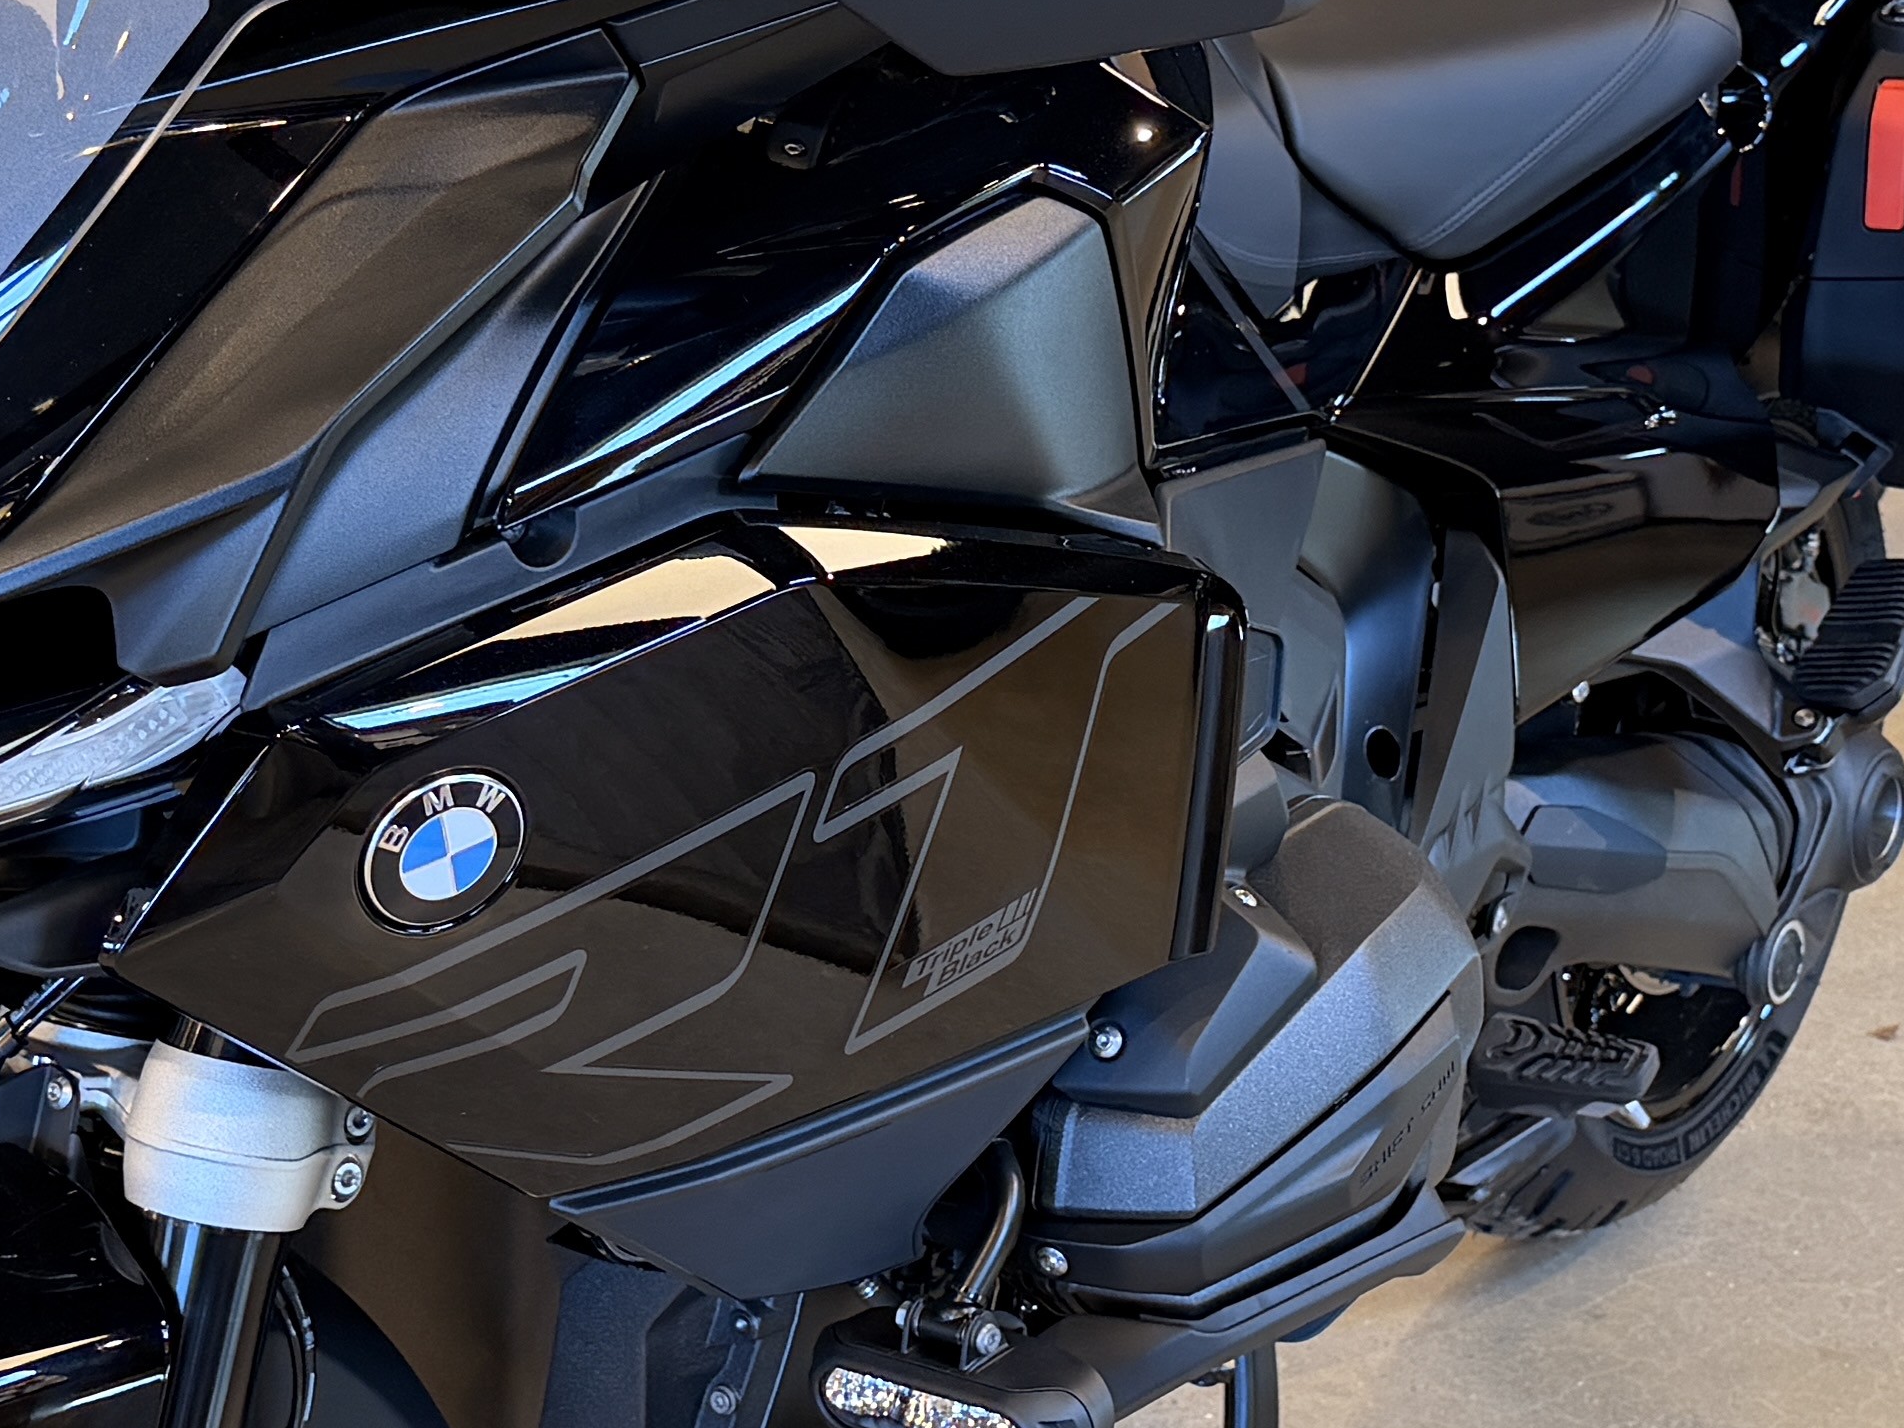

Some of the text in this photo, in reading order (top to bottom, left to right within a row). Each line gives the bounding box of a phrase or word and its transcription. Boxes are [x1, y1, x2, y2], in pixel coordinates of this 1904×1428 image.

[377, 784, 507, 853] BMW
[916, 922, 994, 976] Triple
[937, 927, 1016, 987] Black
